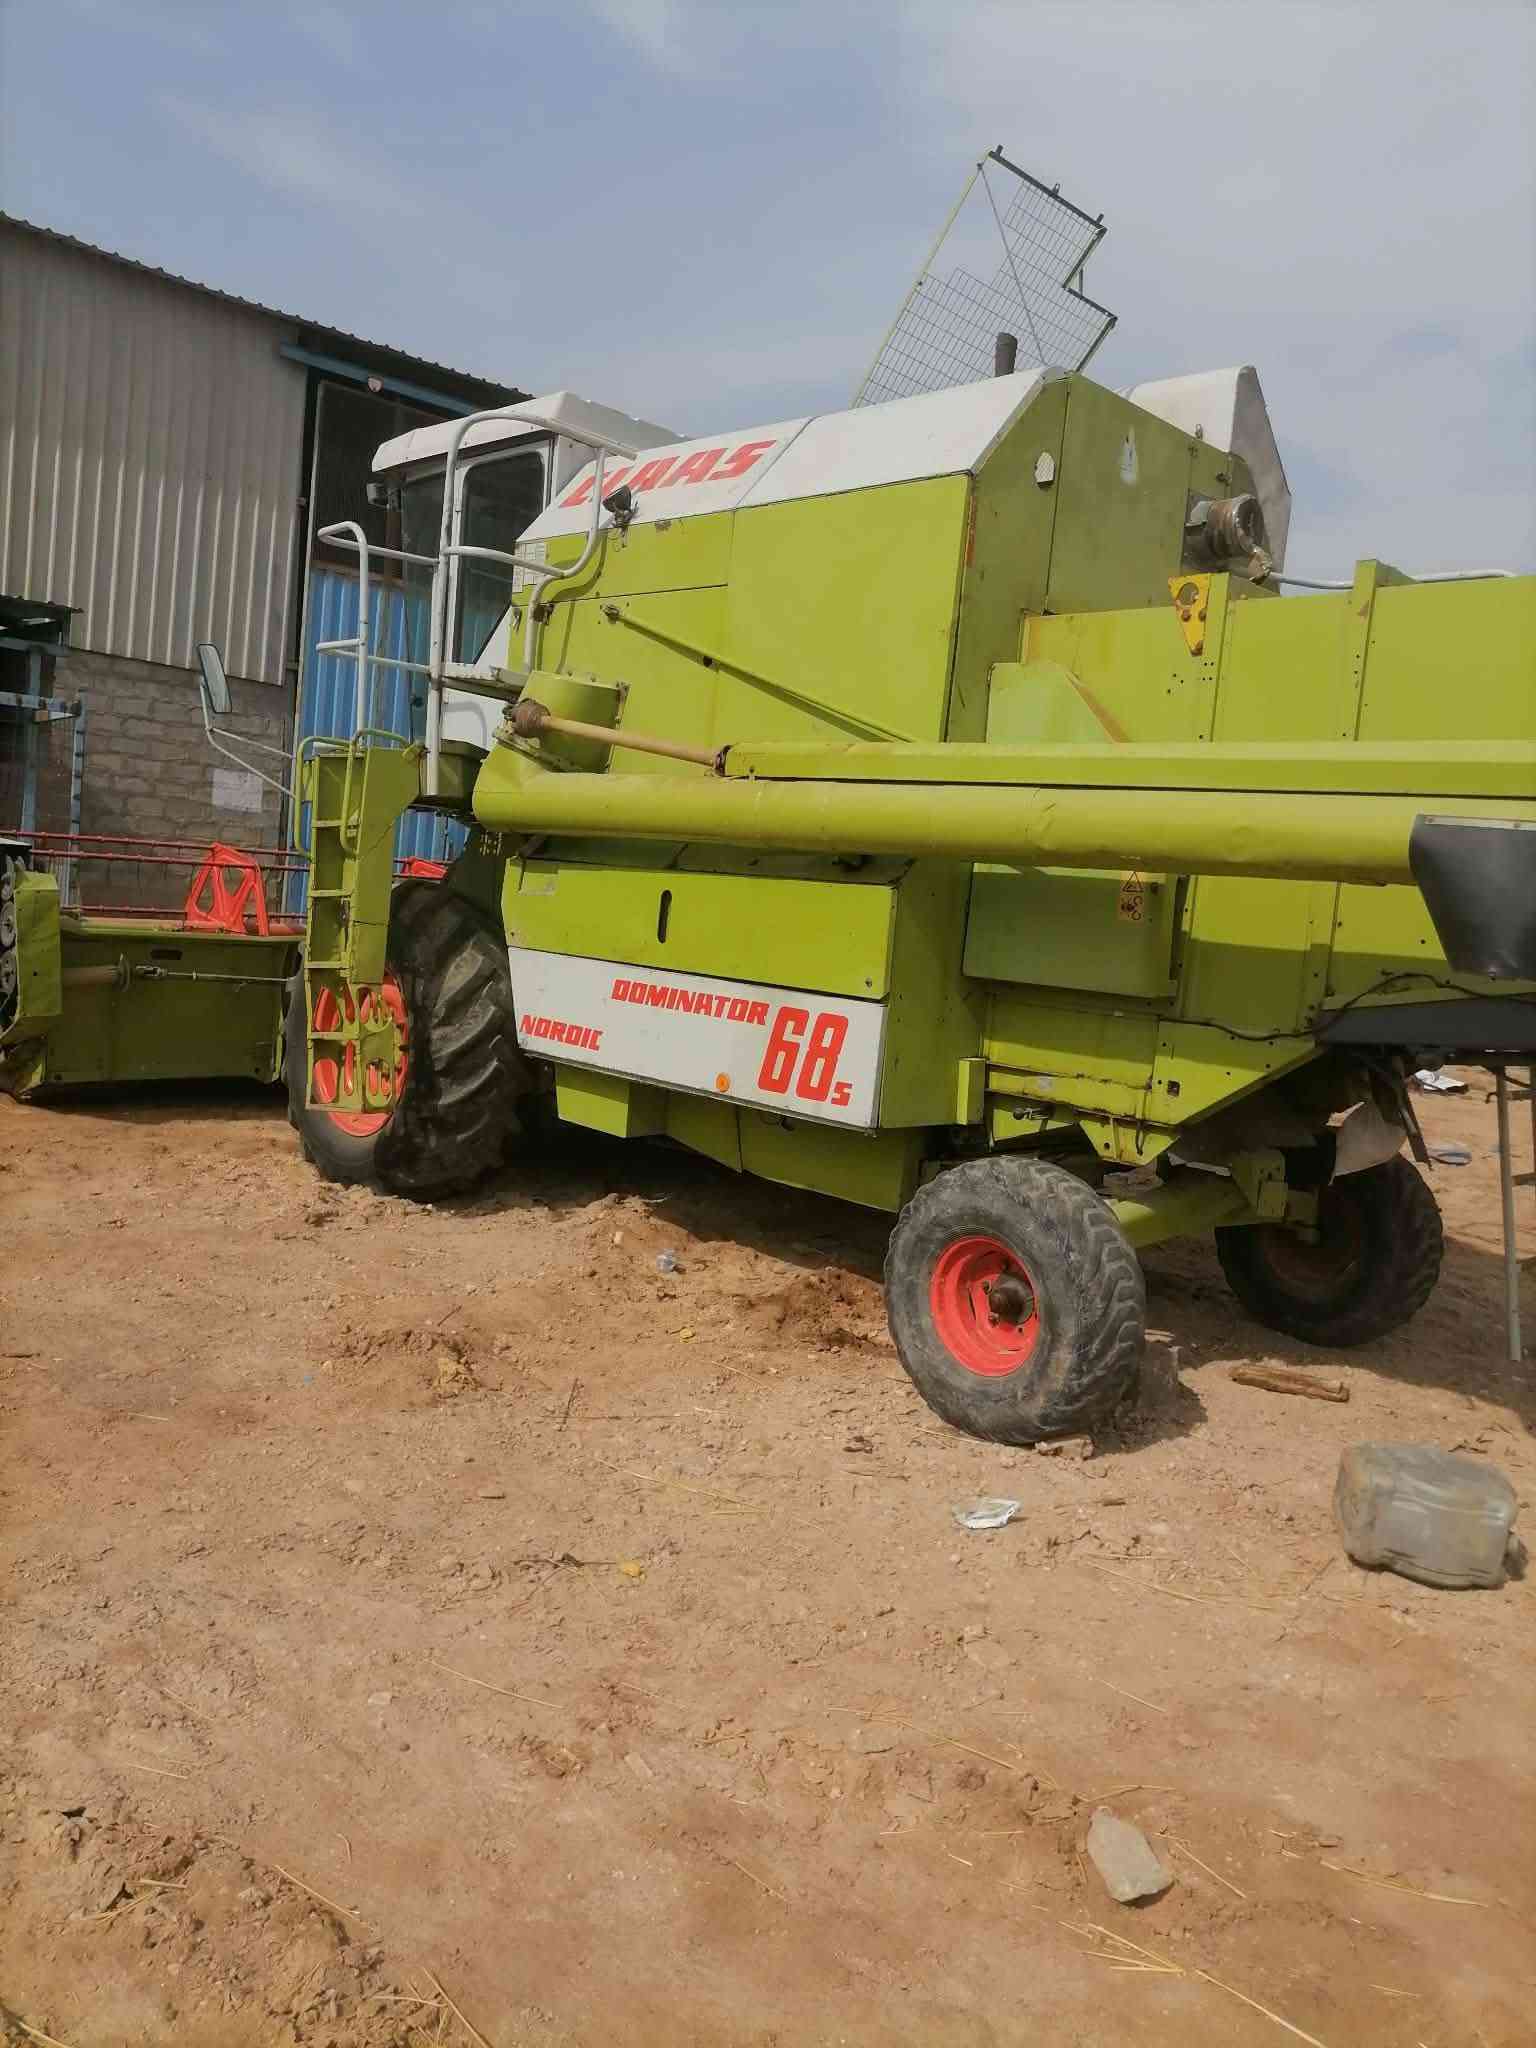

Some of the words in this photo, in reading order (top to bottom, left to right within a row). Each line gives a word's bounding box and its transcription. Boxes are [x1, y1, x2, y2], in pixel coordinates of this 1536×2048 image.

[559, 439, 777, 509] CLAAS
[610, 979, 771, 1026] DOMINATOR
[520, 1014, 603, 1051] NORDIC
